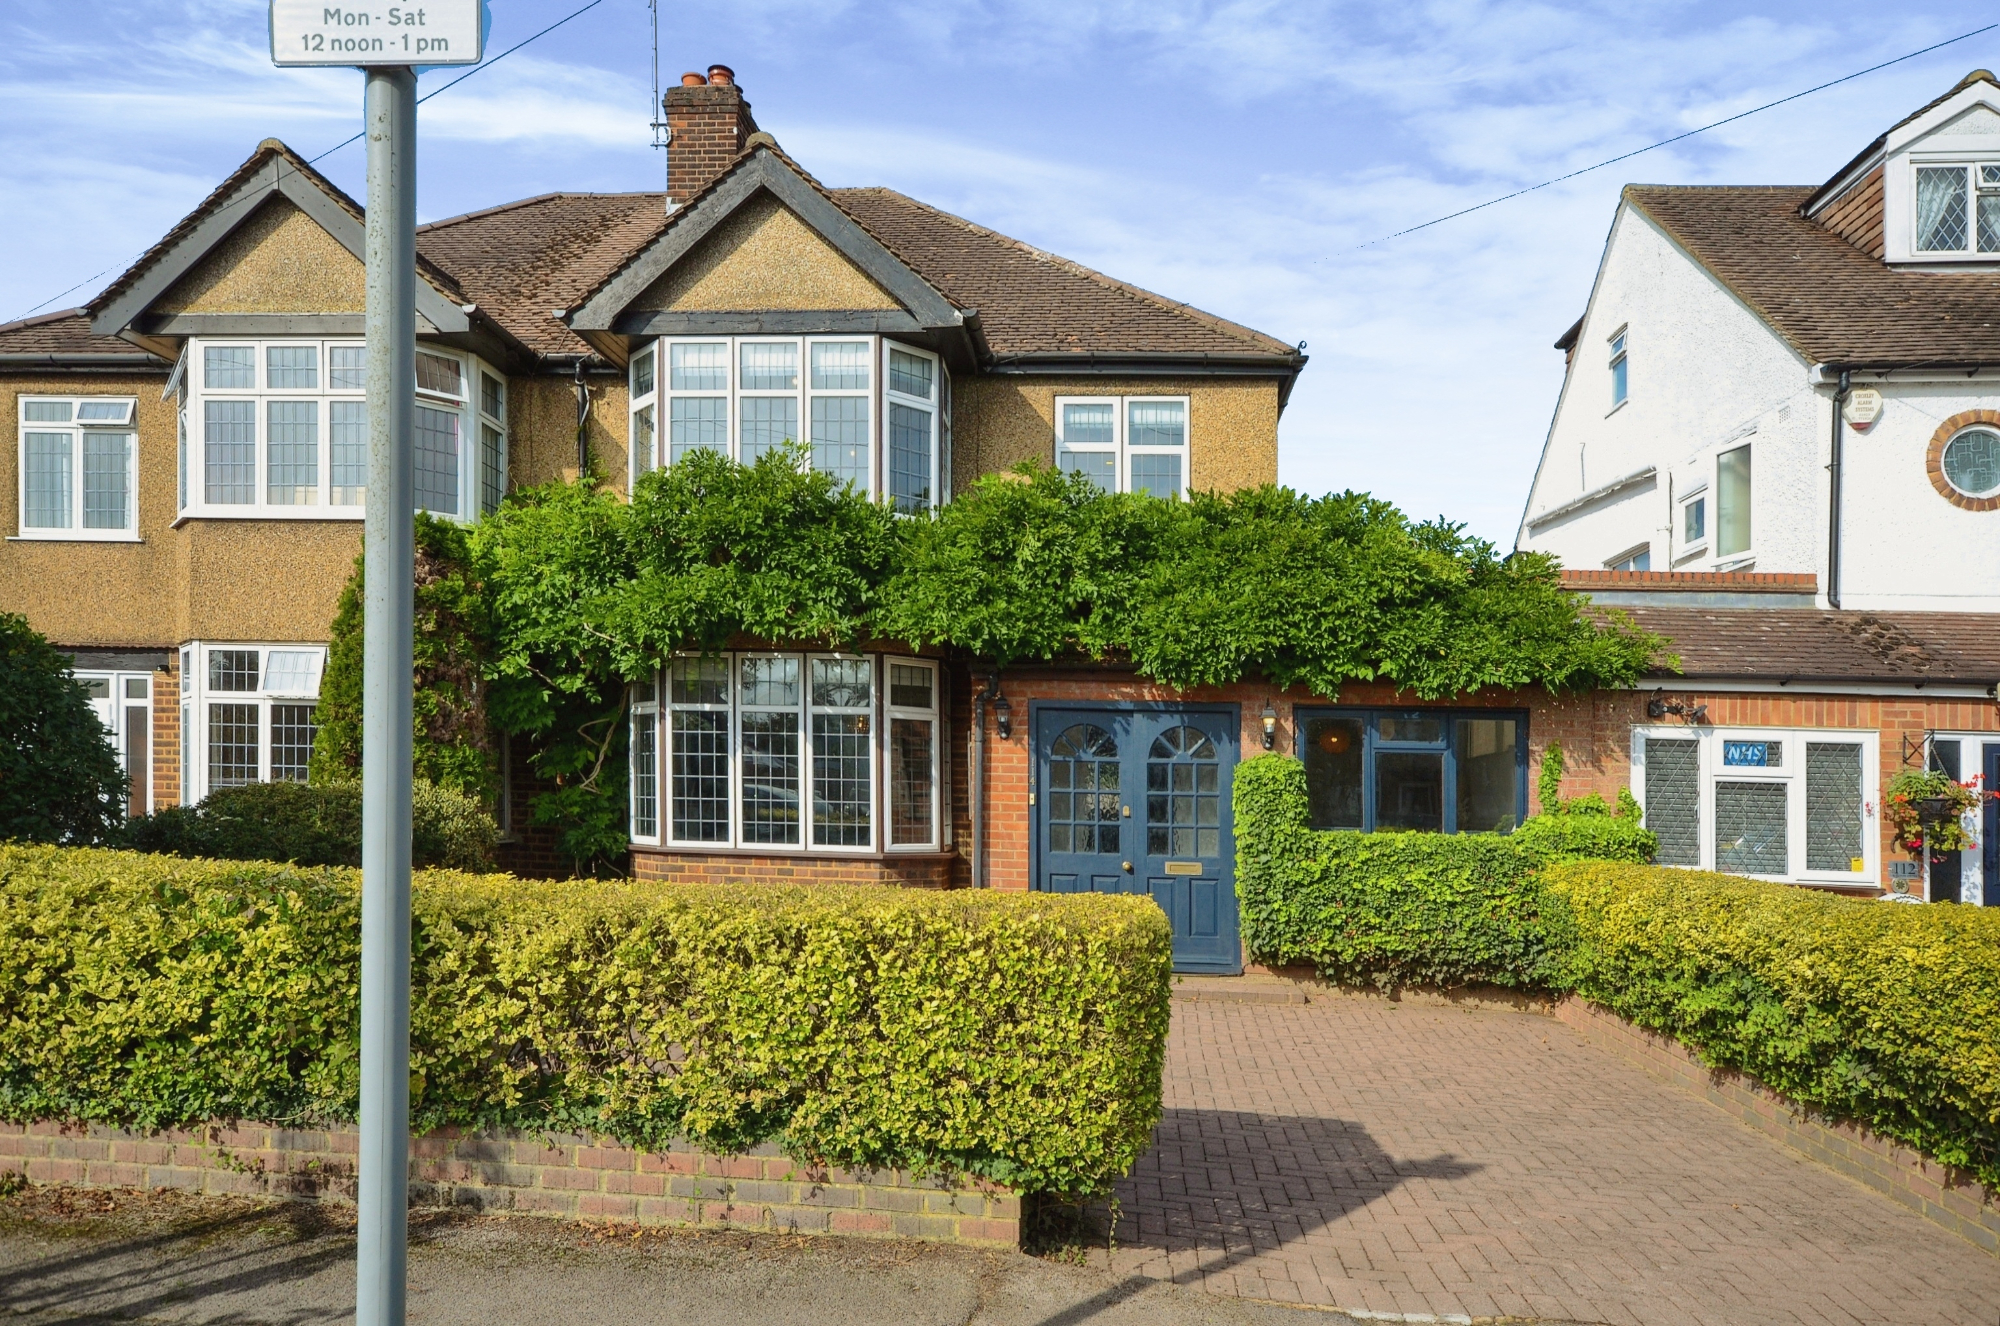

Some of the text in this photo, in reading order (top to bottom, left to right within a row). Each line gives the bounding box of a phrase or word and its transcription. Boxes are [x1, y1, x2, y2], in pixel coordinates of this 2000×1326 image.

[323, 8, 370, 26] Mon
[388, 7, 426, 26] Sat
[301, 33, 324, 52] 12
[331, 37, 383, 52] noon
[1728, 746, 1763, 760] NHS
[1894, 863, 1916, 875] 112
